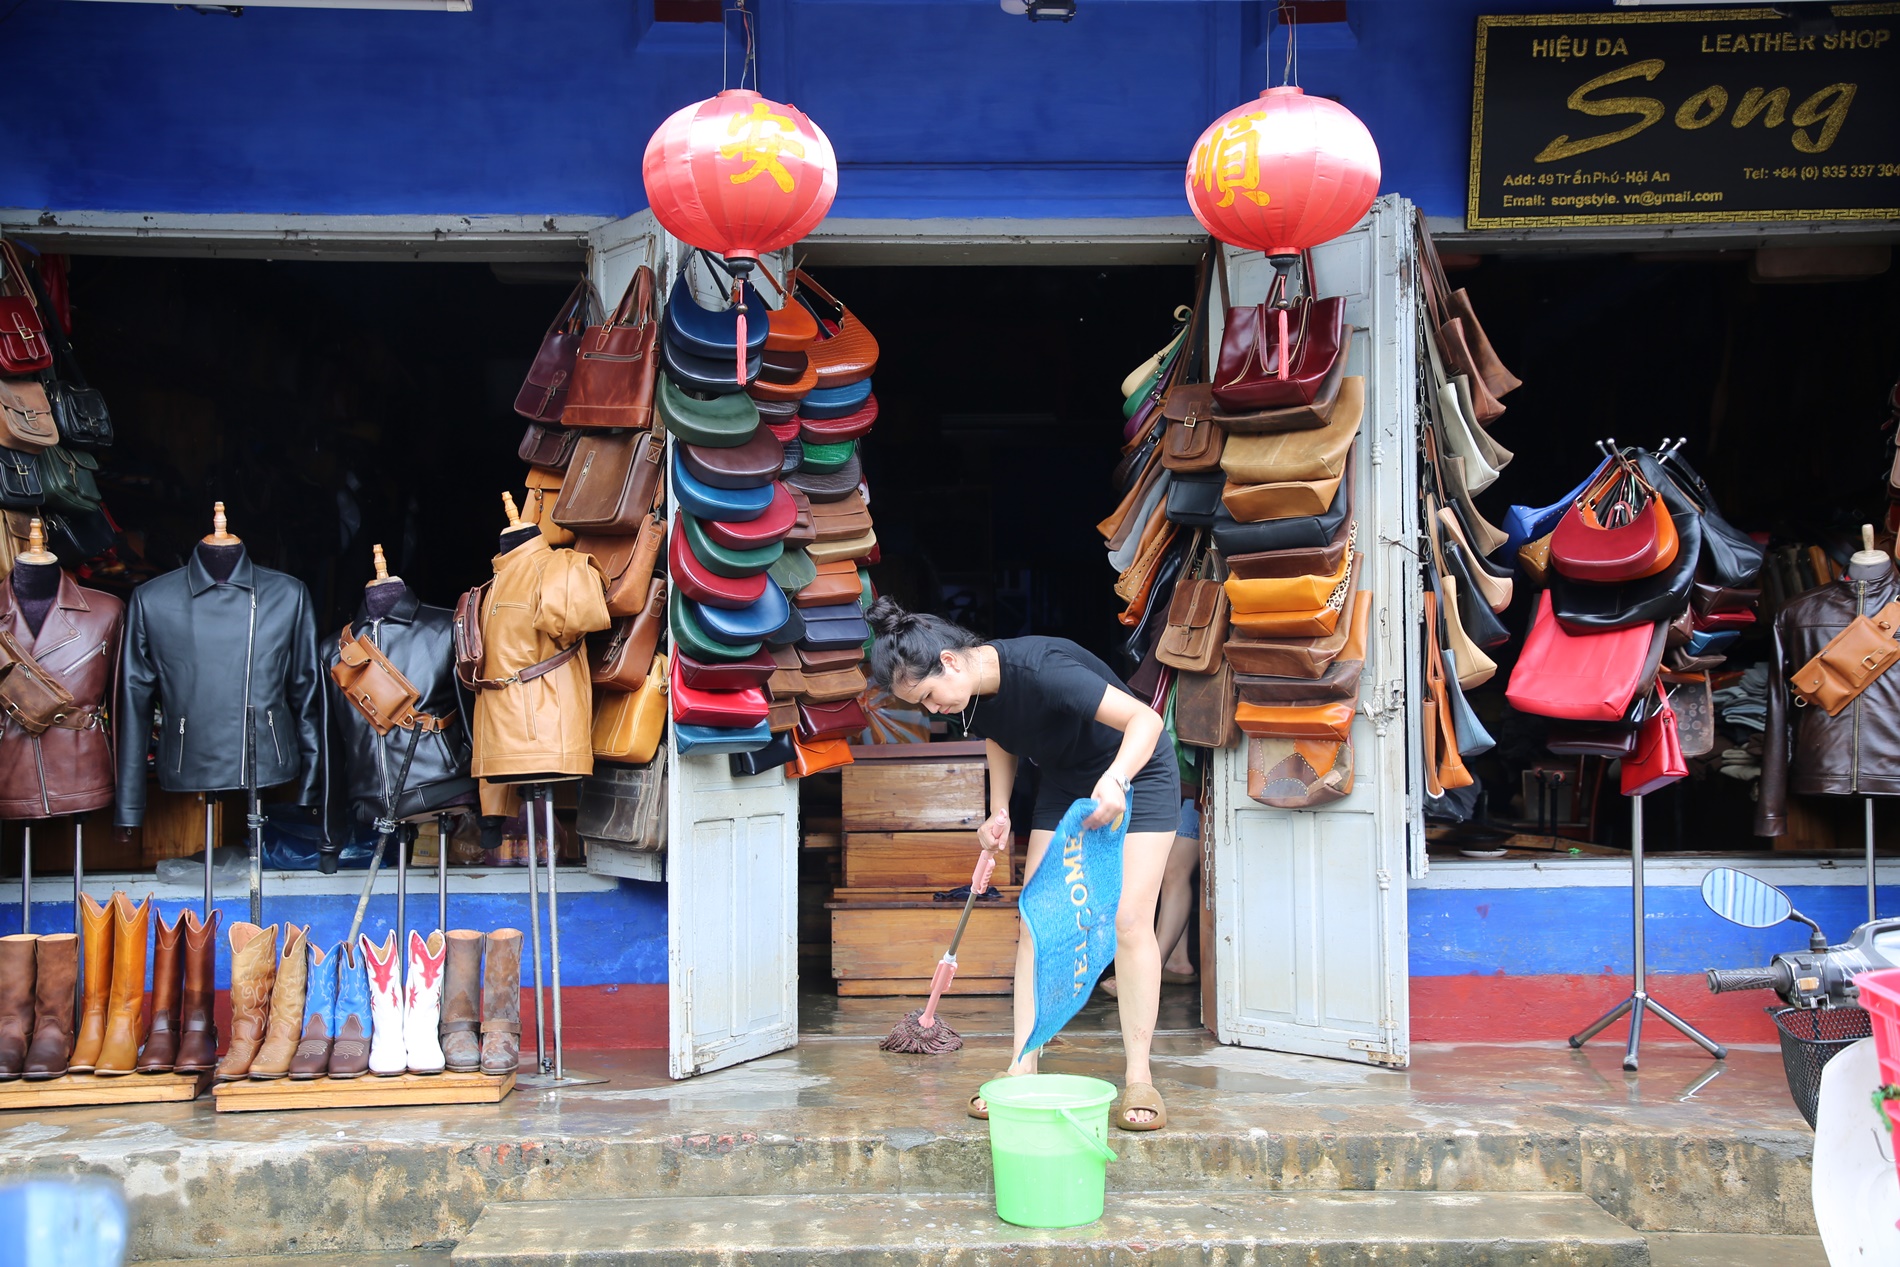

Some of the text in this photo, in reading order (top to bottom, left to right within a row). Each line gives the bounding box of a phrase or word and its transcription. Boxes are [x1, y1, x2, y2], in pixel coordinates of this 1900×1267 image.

[1532, 34, 1629, 62] HIỆU DA
[1701, 29, 1891, 53] LEATHER SHOP
[1534, 58, 1858, 163] Song
[720, 102, 805, 193] 安
[1193, 111, 1270, 208] 順
[1503, 174, 1536, 186] Add:
[1651, 170, 1671, 182] An
[1744, 167, 1768, 179] Tel:
[1773, 167, 1797, 178] +84
[1801, 166, 1819, 180] (0)
[1822, 165, 1847, 178] 935
[1850, 164, 1875, 177] 337
[1503, 194, 1546, 207] Email:
